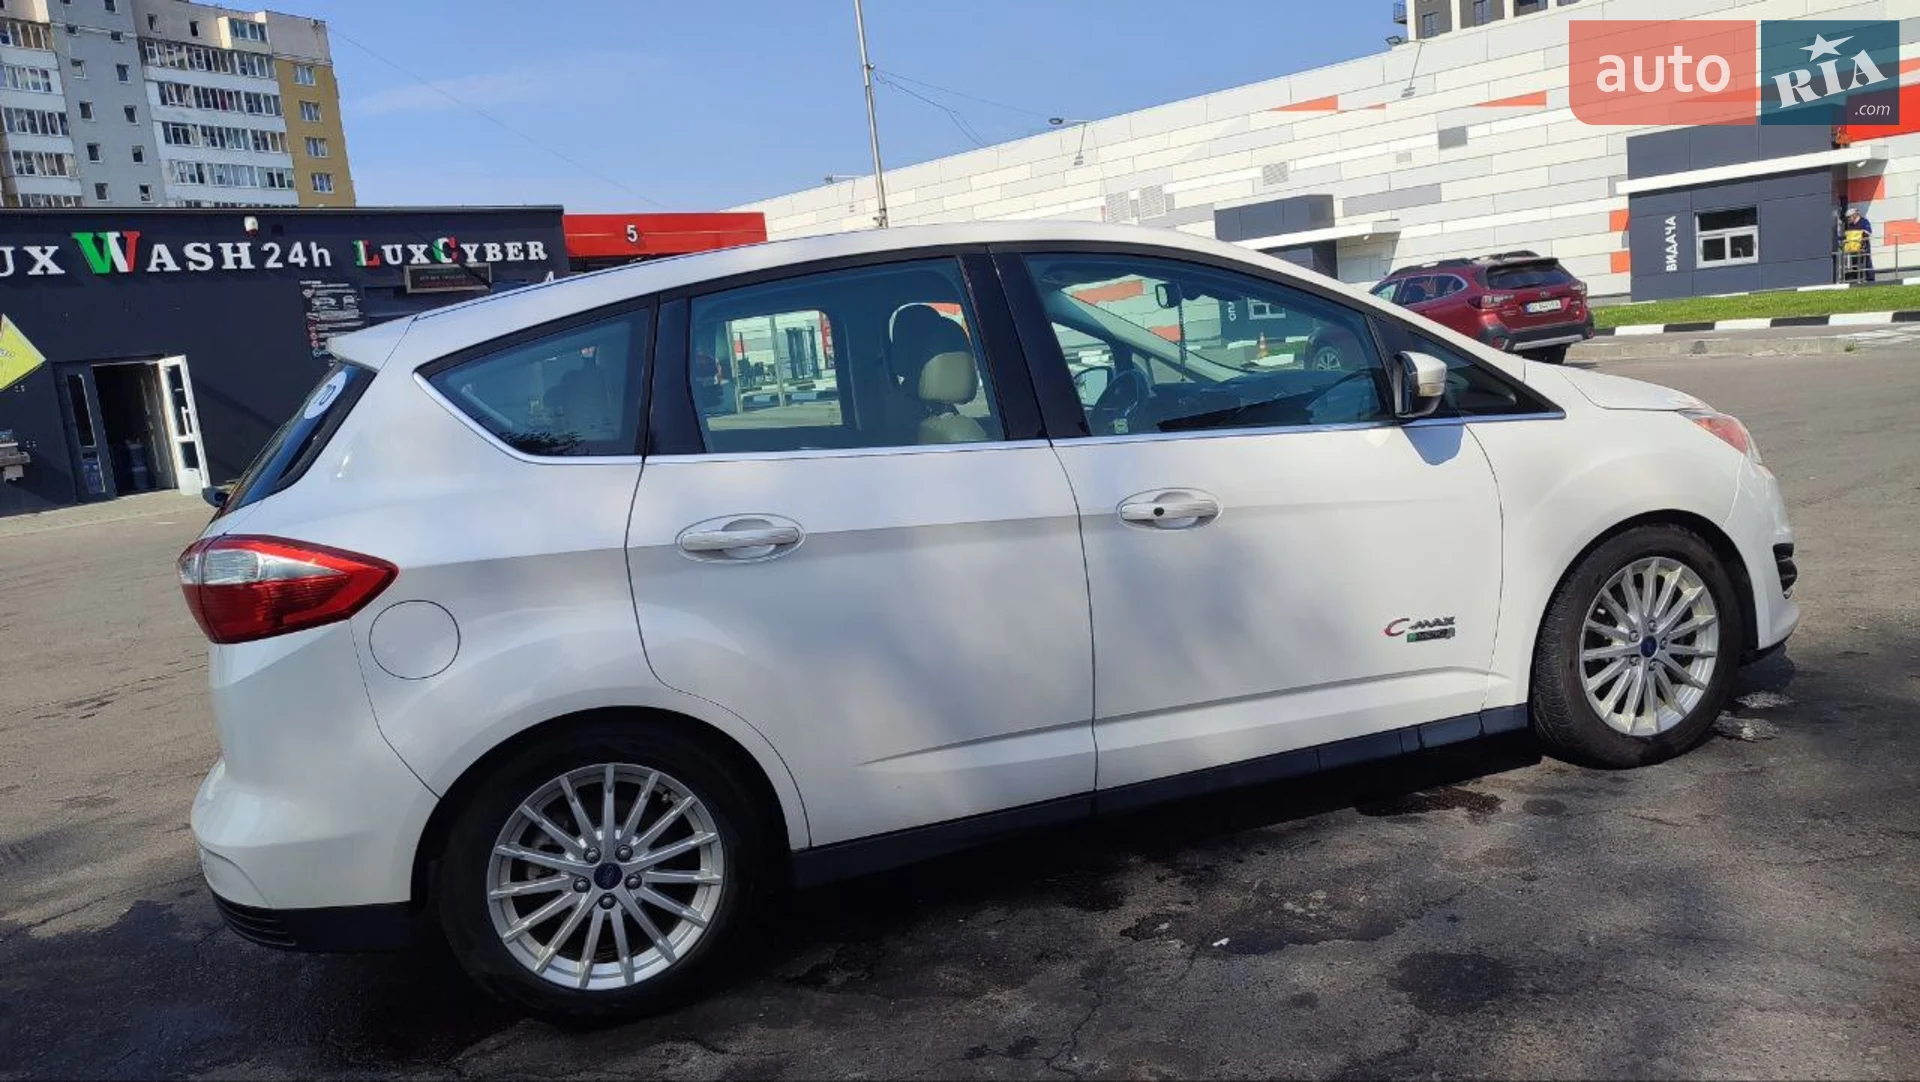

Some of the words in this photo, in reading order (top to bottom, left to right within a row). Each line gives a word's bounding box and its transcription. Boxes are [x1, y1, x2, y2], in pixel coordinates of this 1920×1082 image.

[71, 231, 256, 275] WASH
[261, 241, 332, 268] 24h
[626, 224, 639, 243] 5
[1664, 215, 1679, 272] ВИДАЧА
